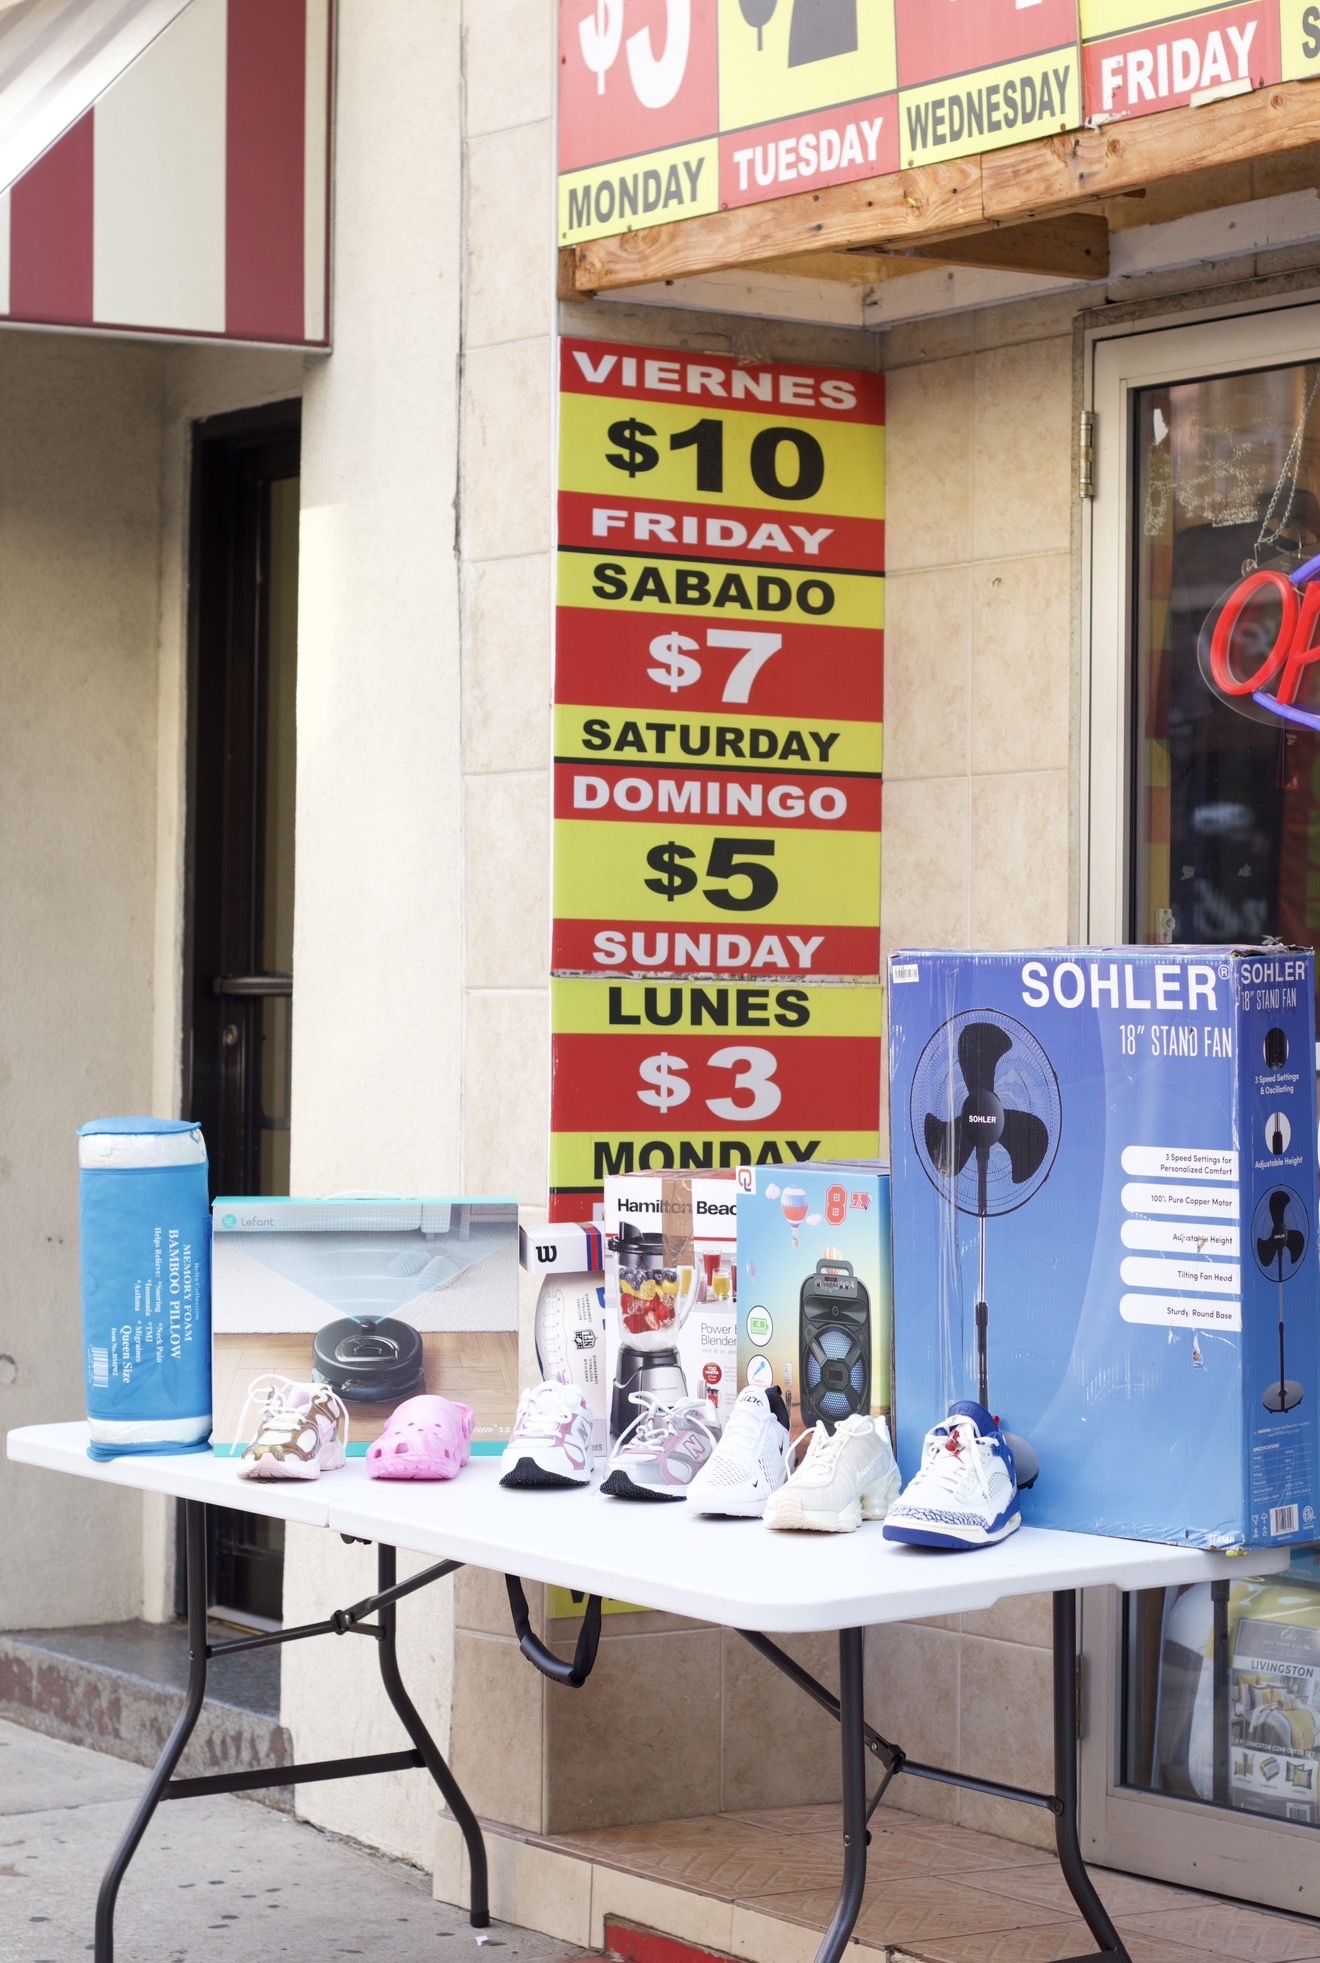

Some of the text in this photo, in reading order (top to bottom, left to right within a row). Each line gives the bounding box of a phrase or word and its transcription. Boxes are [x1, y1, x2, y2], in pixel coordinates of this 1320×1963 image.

[1101, 21, 1258, 111] FRIDAY
[906, 65, 1070, 152] WEDNESDAY
[733, 117, 885, 190] TUESDAY
[568, 156, 706, 231] MONDAY
[572, 351, 857, 410] VIERNES
[605, 417, 825, 501] $10
[592, 508, 835, 555] FRIDAY
[592, 563, 835, 616] SABADO
[646, 628, 782, 704] $7
[581, 719, 841, 762] SATURDAY
[573, 775, 847, 820] DOMINGO
[644, 837, 779, 912] $5
[592, 930, 826, 968] SUNDAY
[608, 986, 811, 1028] LUNES
[1256, 988, 1280, 1010] STAND
[1282, 987, 1297, 1008] FAN
[1151, 1025, 1198, 1057] STAND
[1204, 1027, 1232, 1058] FAN
[1254, 1072, 1300, 1085] 3 Speed Settings
[1265, 1085, 1294, 1095] Oscillating
[968, 1115, 997, 1124] SOHLER
[1160, 1164, 1232, 1176] Personalized Comfort
[1165, 1153, 1232, 1166] 3 Speed Settings for
[1255, 1156, 1303, 1170] Adjustable Height
[696, 1201, 737, 1216] Beac
[1150, 1194, 1233, 1207] 100% Pure Copper Motor
[241, 1215, 274, 1227] Lefant
[153, 1227, 161, 1248] Helps
[1210, 1236, 1233, 1246] Height
[1177, 1270, 1233, 1282] Tilting Fan Head
[168, 1229, 181, 1359] BAMBOO PILLOW
[183, 1244, 192, 1342] MEMORY FOAM
[1192, 1308, 1214, 1318] Round
[1215, 1310, 1233, 1320] Base
[582, 1331, 593, 1347] NFL
[700, 1322, 732, 1335] Power
[701, 1334, 737, 1347] Blender
[120, 1325, 133, 1384] Queen Size
[1251, 1660, 1314, 1678] LIVINGSTON
